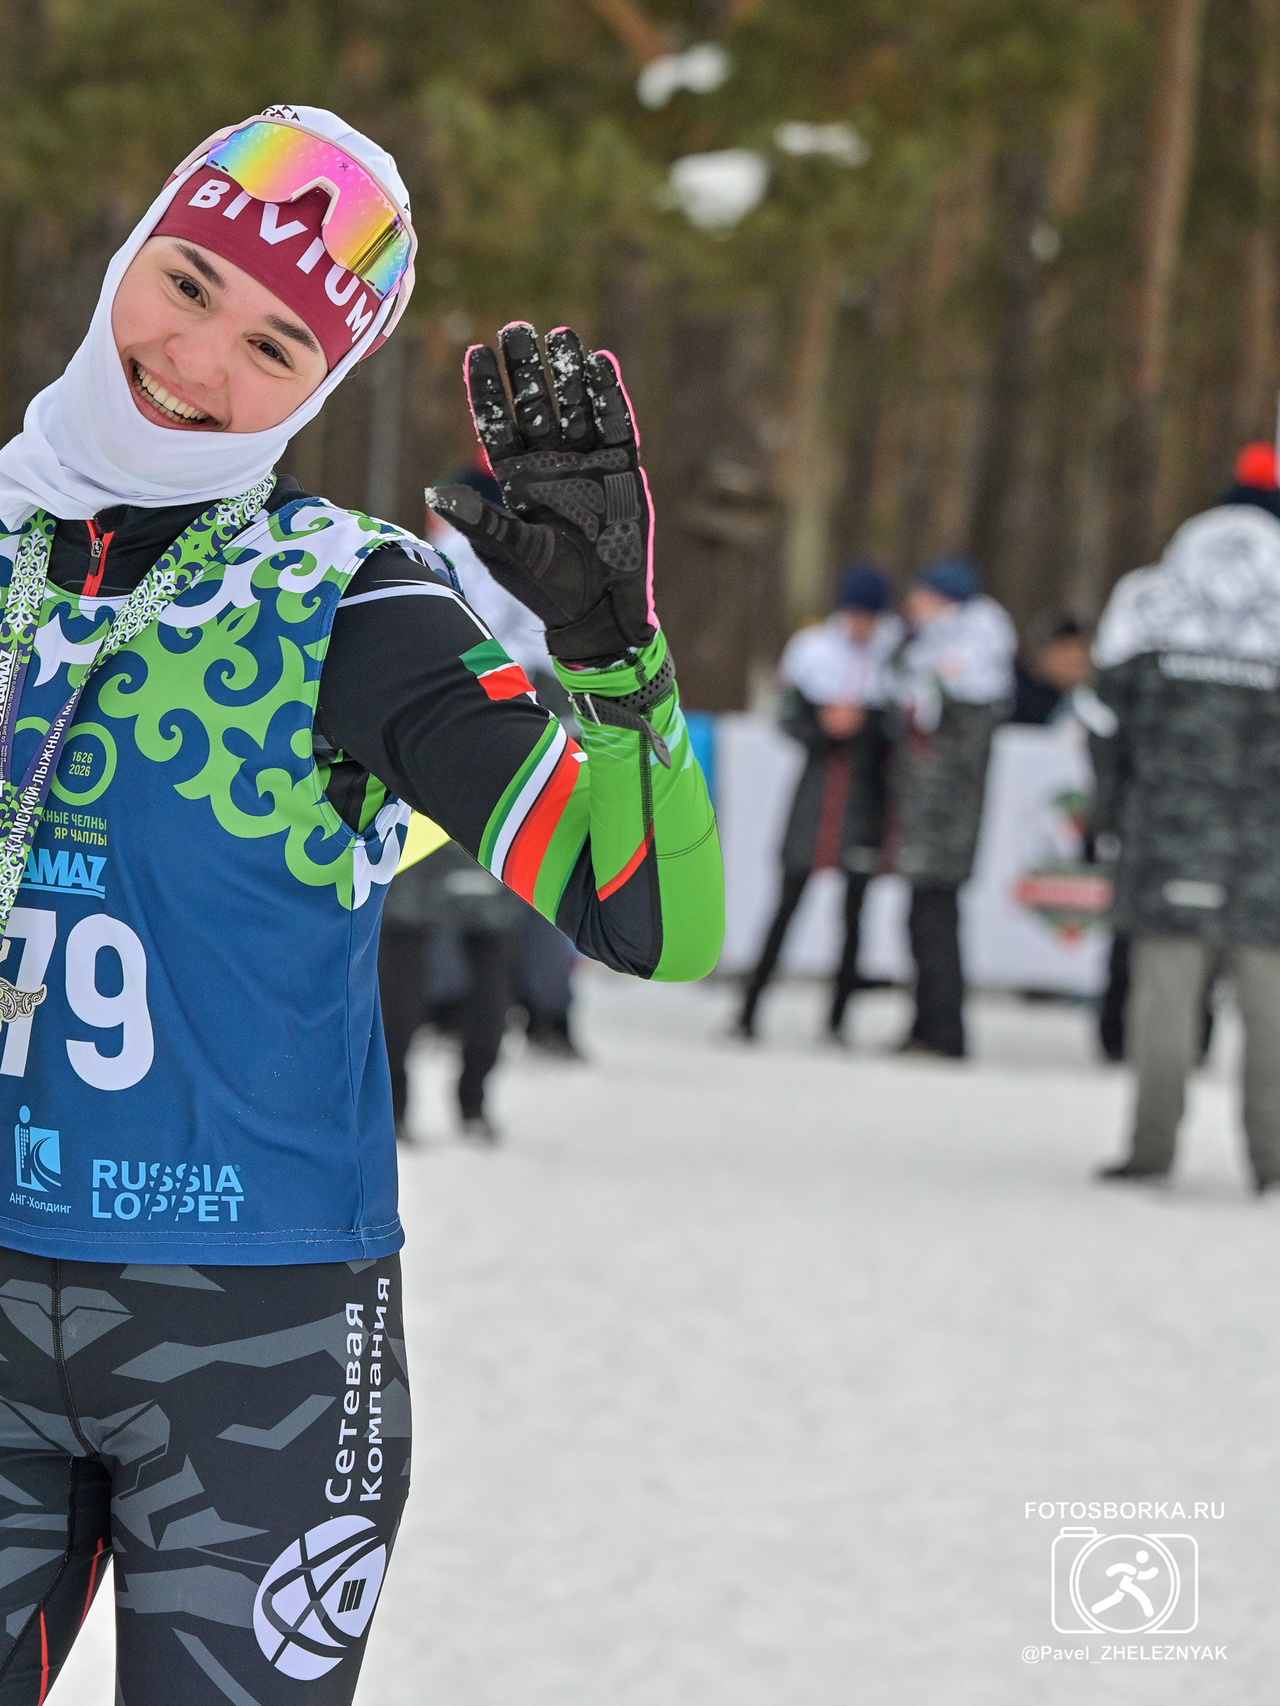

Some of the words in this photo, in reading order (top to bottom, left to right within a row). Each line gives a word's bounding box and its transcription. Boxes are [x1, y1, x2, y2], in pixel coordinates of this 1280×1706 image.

[188, 179, 373, 343] BIVIUM
[69, 764, 91, 777] 2026
[72, 751, 93, 764] 1626
[5, 786, 41, 852] КАМСКИЙ
[32, 718, 67, 785] ЛЫЖНЫЙ
[54, 827, 68, 839] ЯР
[70, 829, 107, 846] ЧАЛЛЫ
[71, 813, 107, 831] ЧЕЛНЫ
[92, 1159, 244, 1193] RUSSIA
[9, 1192, 72, 1214] АНГ-Холдинг
[92, 1191, 245, 1222] LOPPET
[324, 1302, 364, 1504] Сетевая
[360, 1277, 391, 1502] Компания
